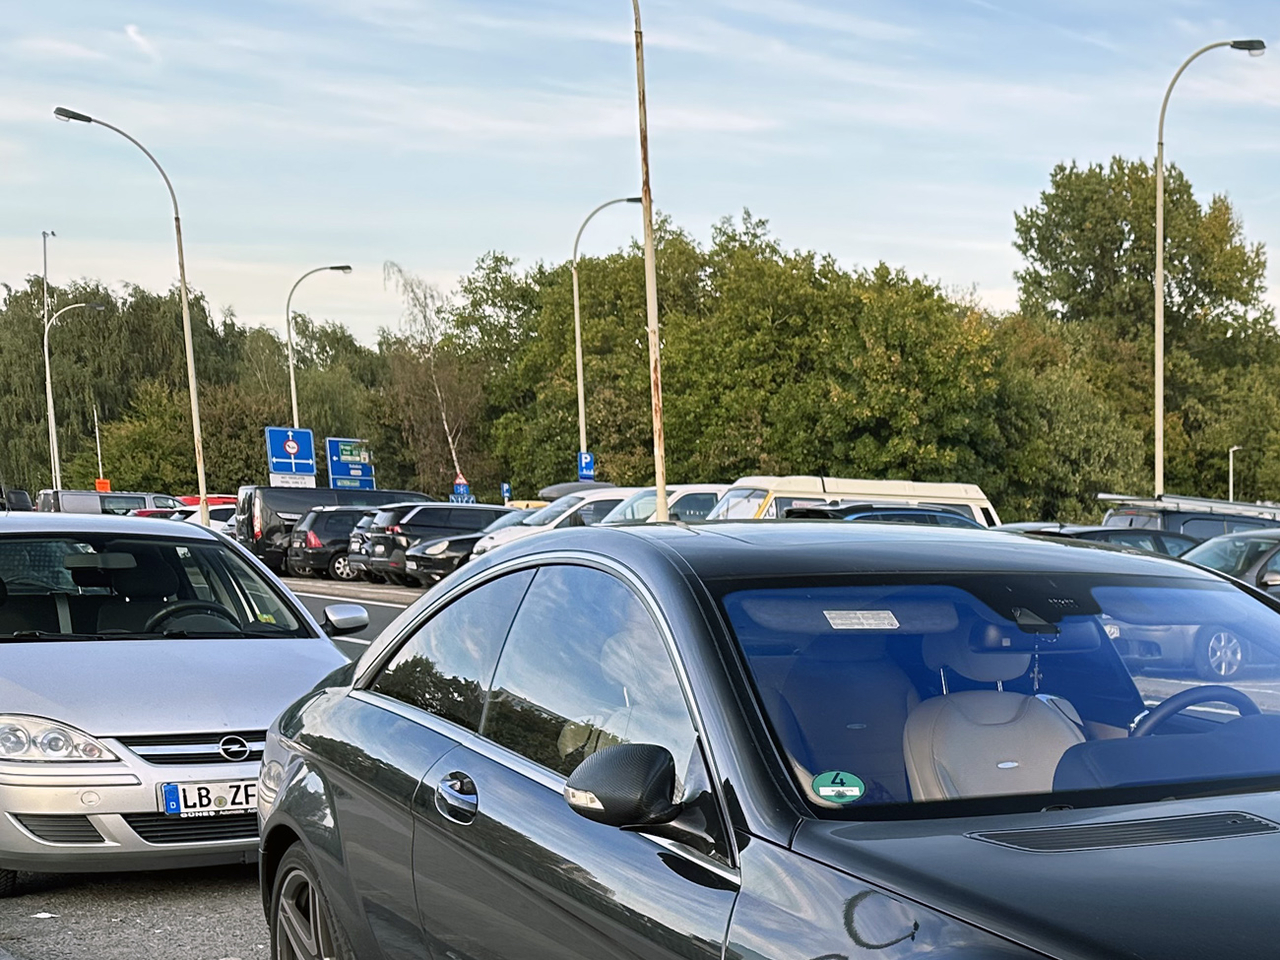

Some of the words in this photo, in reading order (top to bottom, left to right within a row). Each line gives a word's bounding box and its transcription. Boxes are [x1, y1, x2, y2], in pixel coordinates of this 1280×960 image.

[581, 454, 591, 467] P
[503, 483, 509, 492] P
[831, 772, 846, 786] 4
[182, 786, 212, 809] LB
[229, 783, 256, 806] ZF
[169, 801, 176, 809] D
